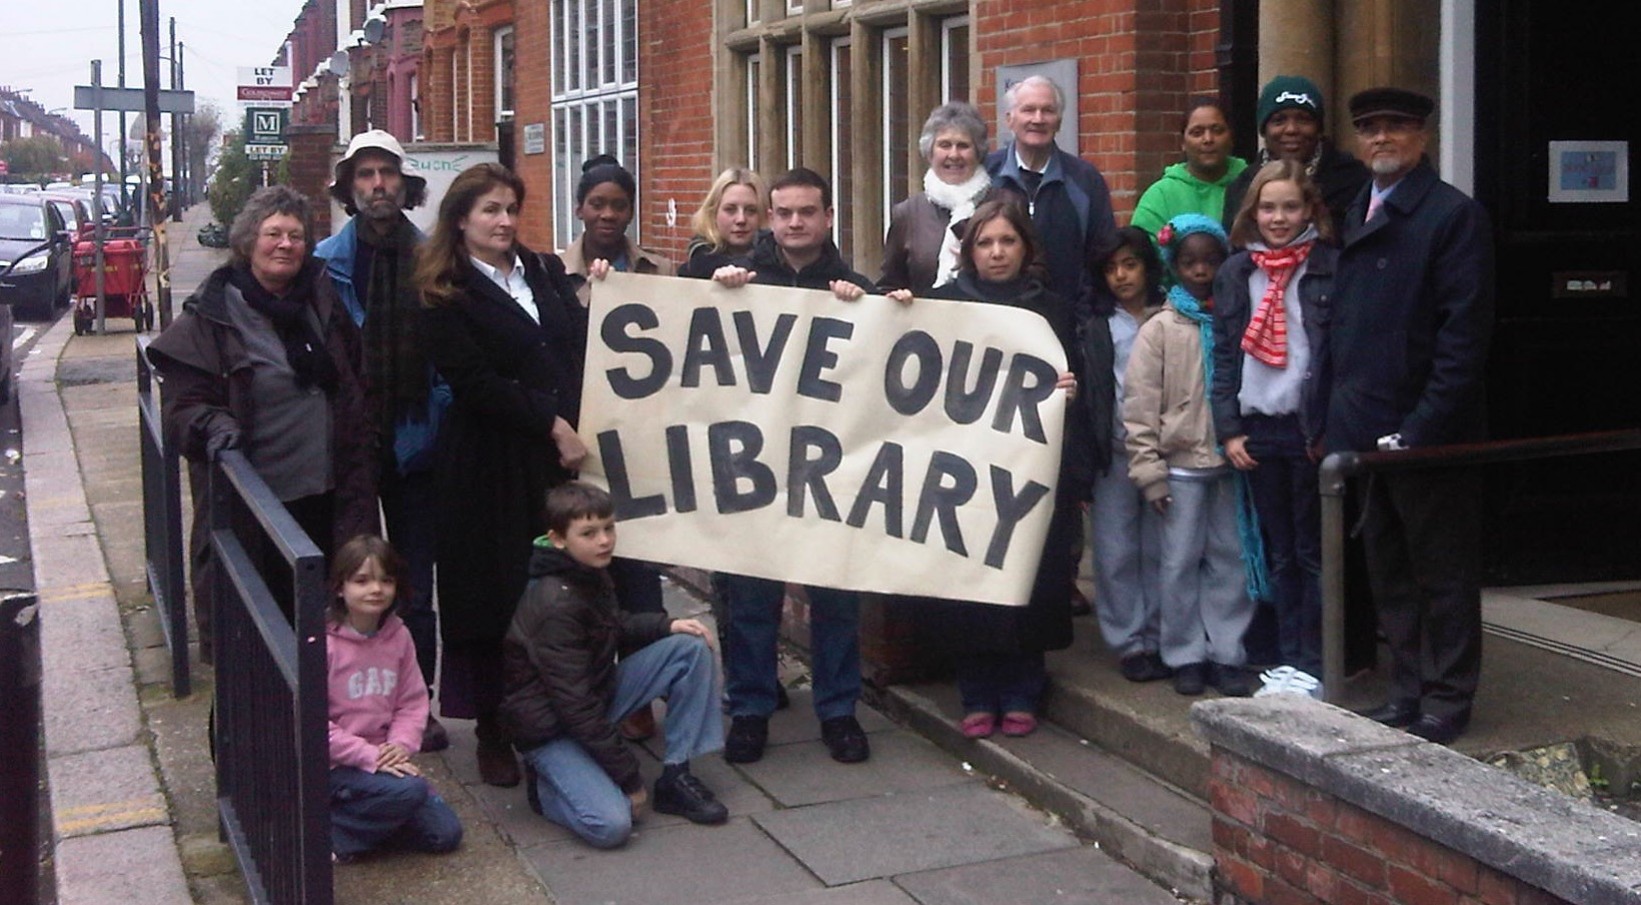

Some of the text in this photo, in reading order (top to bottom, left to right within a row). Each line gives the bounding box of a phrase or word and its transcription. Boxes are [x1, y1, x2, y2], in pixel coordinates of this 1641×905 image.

[254, 67, 275, 76] LET
[256, 77, 273, 85] BY
[258, 116, 276, 131] M
[250, 146, 267, 154] LET
[271, 146, 283, 154] BY
[601, 303, 1060, 444] SAVE OUR
[597, 420, 1050, 570] LIBRARY
[348, 667, 397, 699] GAP
